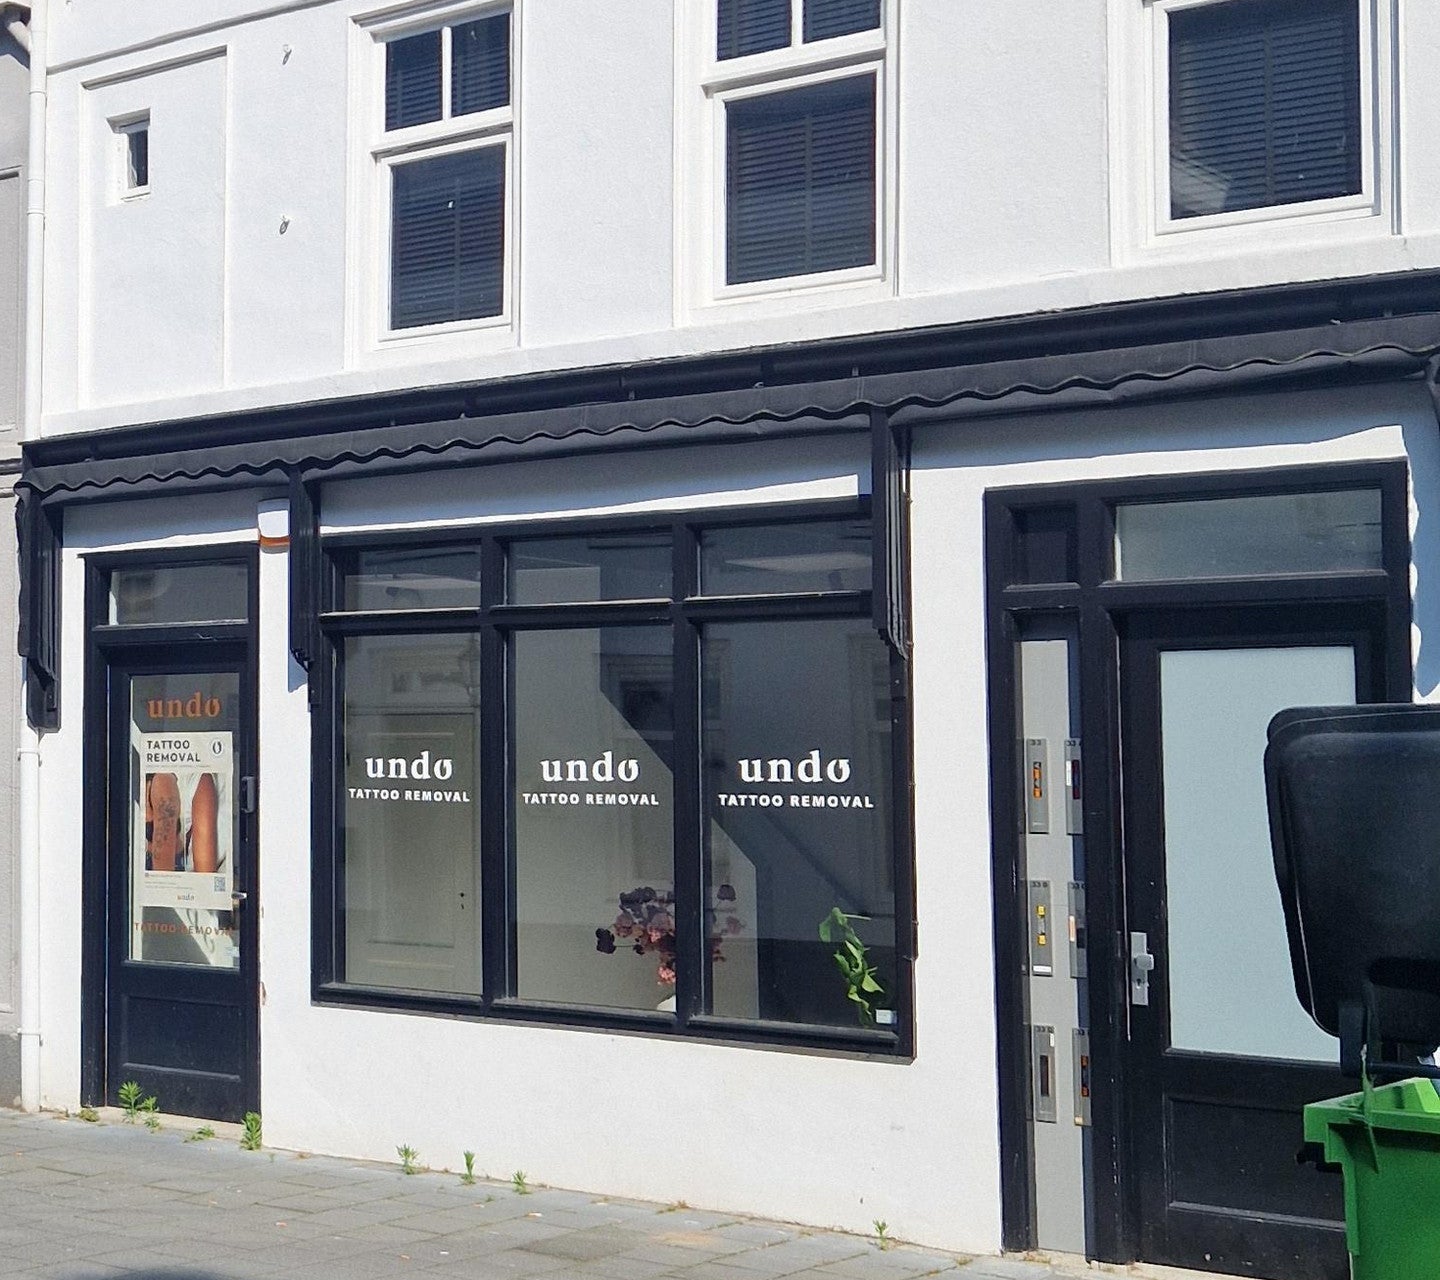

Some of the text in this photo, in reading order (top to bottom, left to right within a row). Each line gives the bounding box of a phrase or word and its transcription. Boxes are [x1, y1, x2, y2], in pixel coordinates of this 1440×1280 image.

[148, 691, 221, 718] undo
[146, 740, 190, 750] TATTOO
[146, 753, 201, 762] REMOVAL
[364, 750, 453, 780] undo
[539, 750, 640, 782] undo
[738, 749, 851, 783] undo
[348, 788, 470, 802] TATTOO REMOVAL
[522, 793, 659, 806] TATTOO REMOVAL
[718, 794, 874, 808] TATTOO REMOVAL
